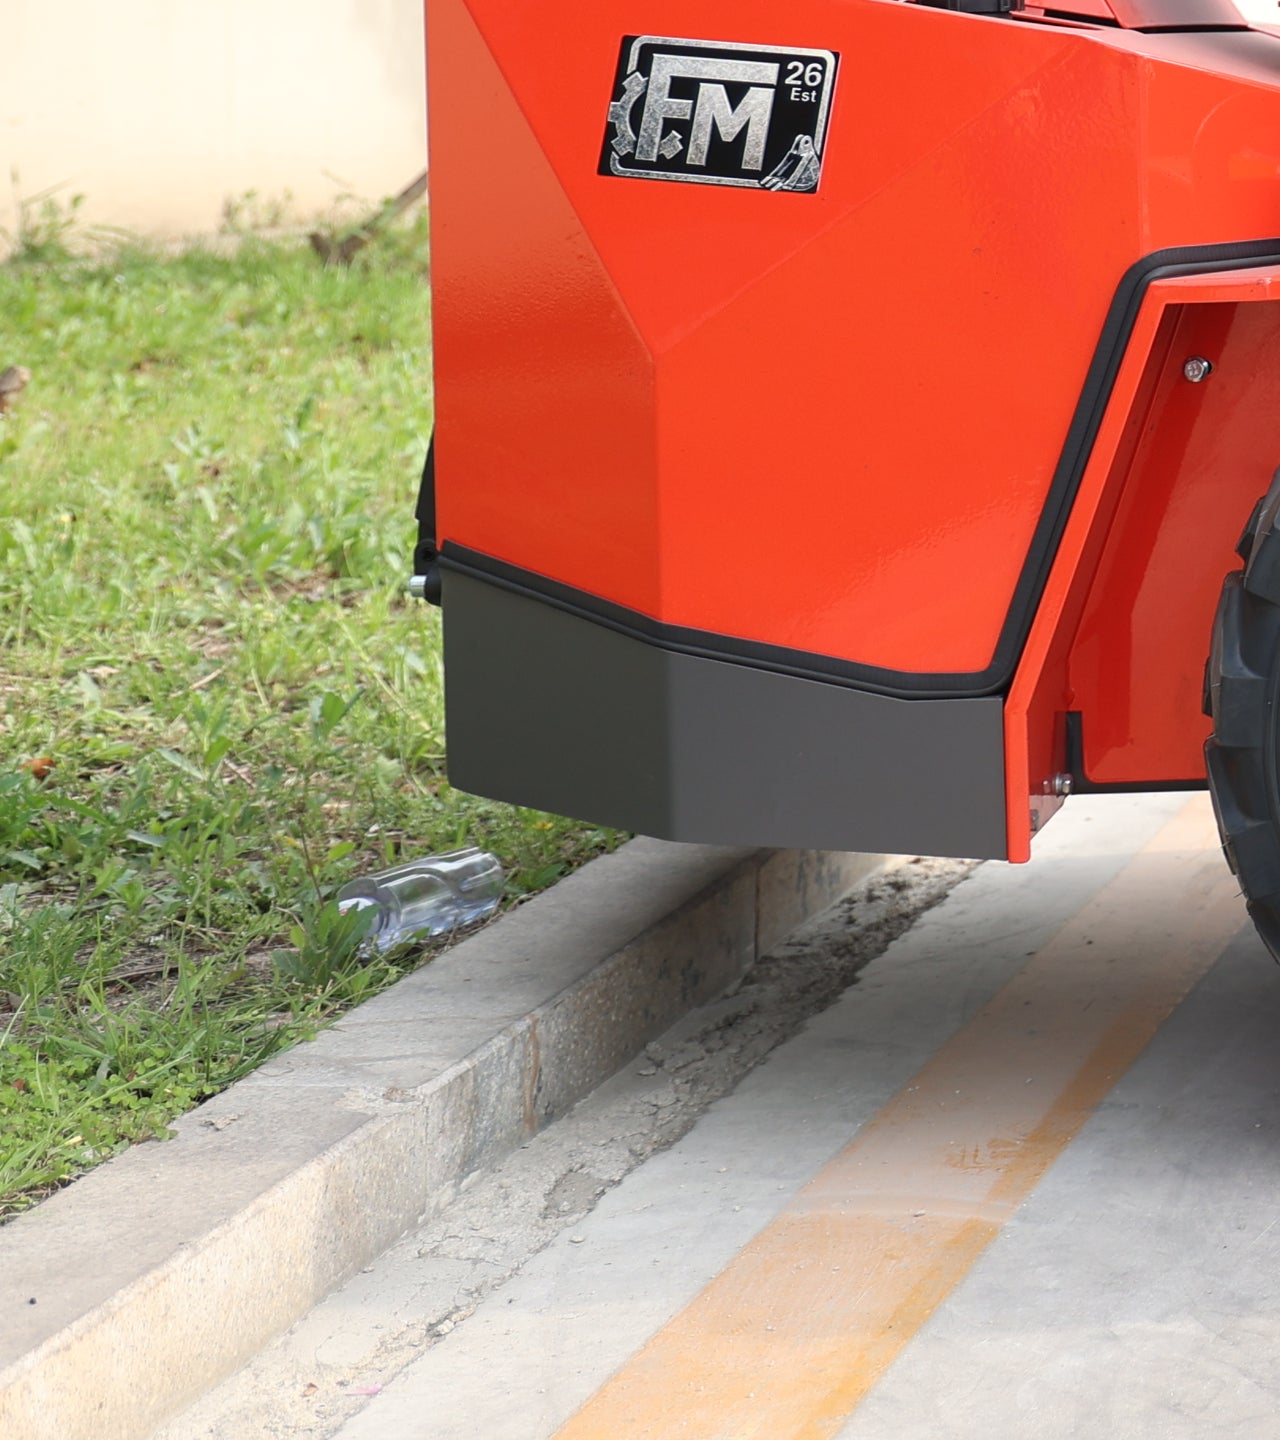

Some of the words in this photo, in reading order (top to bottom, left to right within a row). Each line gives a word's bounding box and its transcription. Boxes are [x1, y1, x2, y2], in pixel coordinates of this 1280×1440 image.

[784, 61, 823, 86] 26
[790, 87, 817, 102] Est
[634, 53, 780, 171] FM
